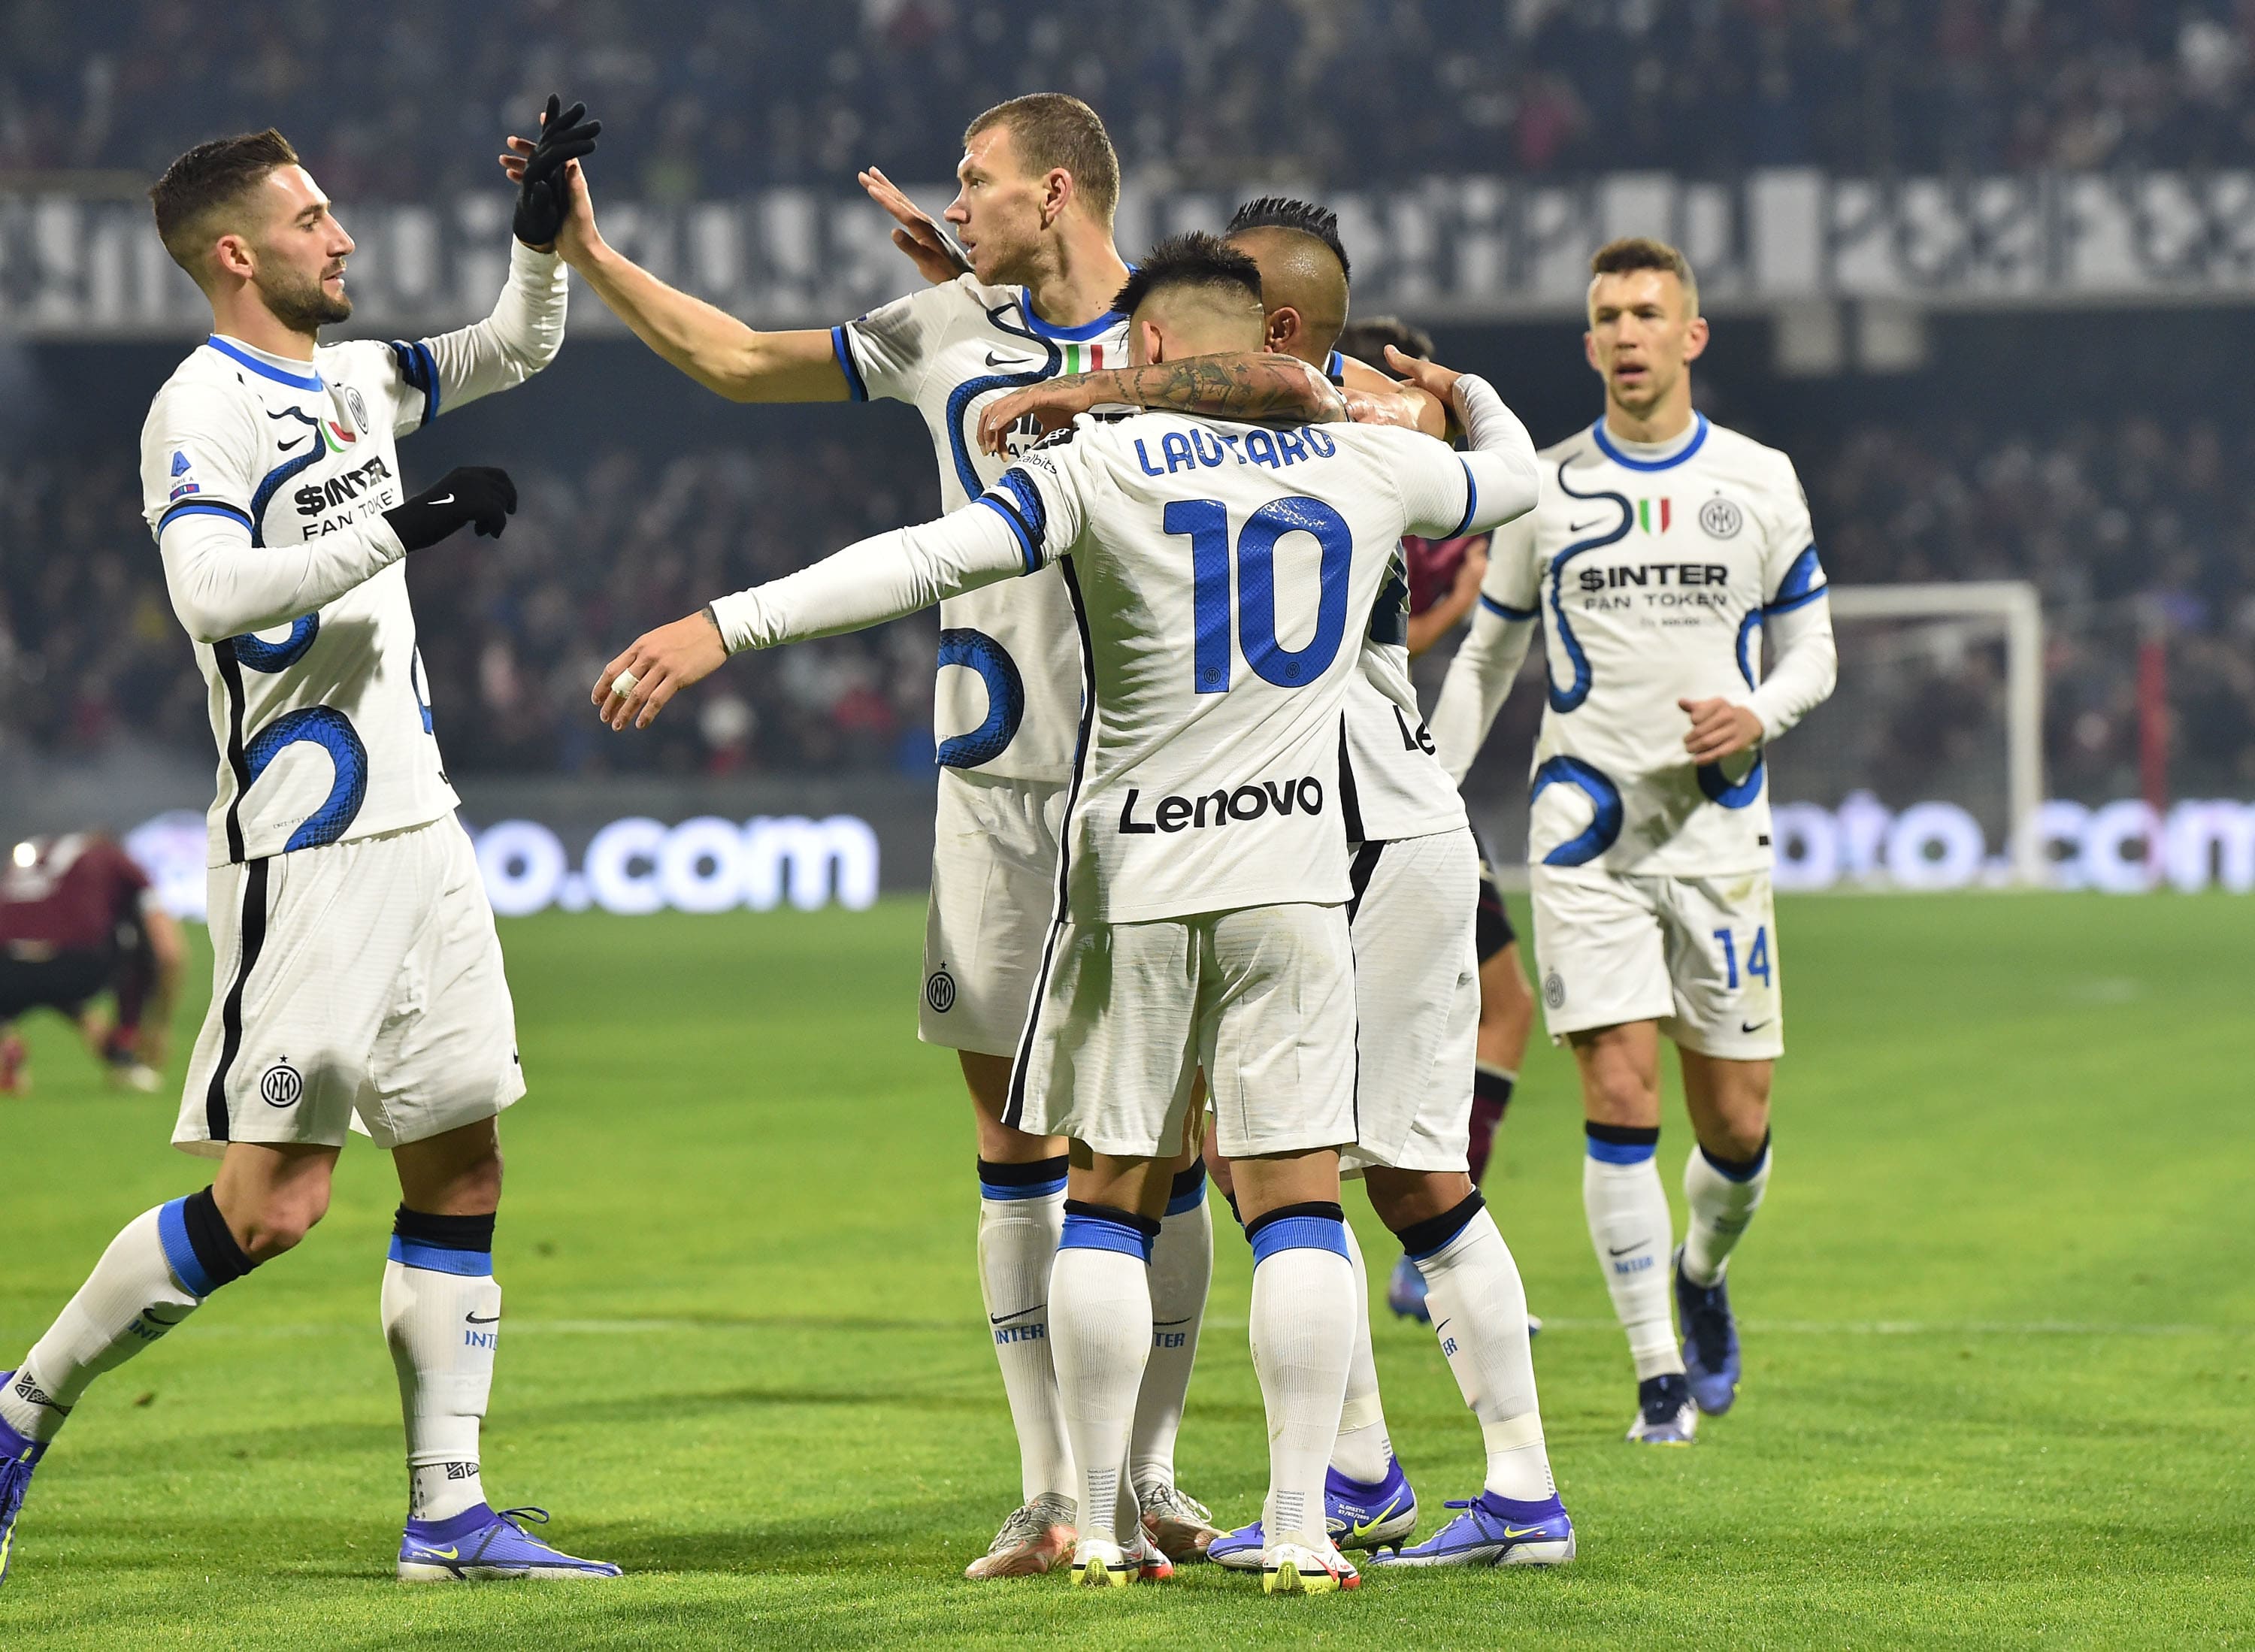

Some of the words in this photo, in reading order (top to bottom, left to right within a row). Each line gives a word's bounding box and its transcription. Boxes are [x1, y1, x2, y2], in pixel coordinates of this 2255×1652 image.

[1134, 426, 1336, 477] LAUTARO
[302, 511, 353, 541] FAN
[359, 488, 393, 519] TOKE
[1163, 495, 1353, 694] 10
[1579, 564, 1728, 592] $INTER
[1585, 596, 1631, 610] FAN
[1644, 592, 1727, 607] TOKEN
[1118, 776, 1323, 834] Lenovo
[1712, 925, 1771, 989] 14
[994, 1323, 1045, 1345] INTER
